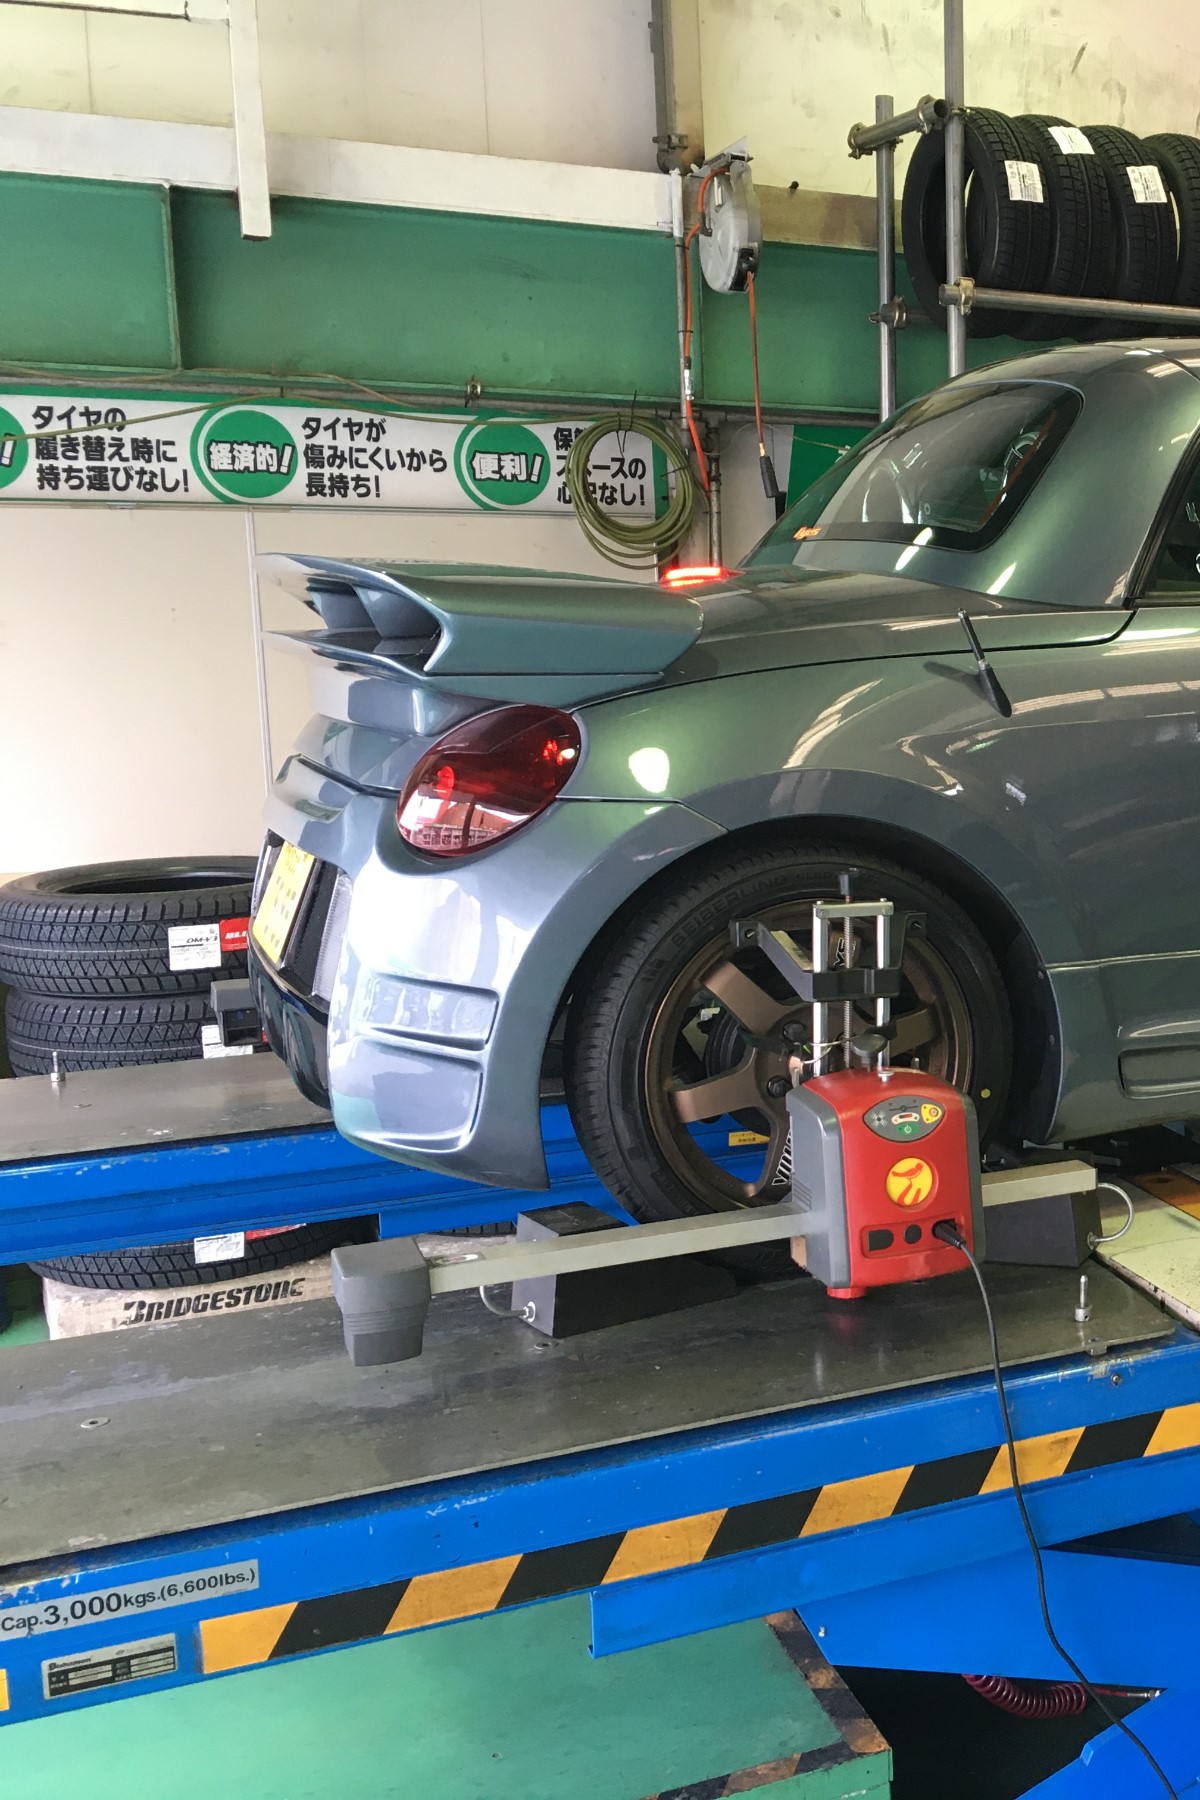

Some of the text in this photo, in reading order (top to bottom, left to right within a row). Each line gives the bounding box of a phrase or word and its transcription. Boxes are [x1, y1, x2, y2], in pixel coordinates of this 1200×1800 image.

[32, 405, 127, 432] タイヤの
[301, 417, 387, 442] タイヤが
[35, 434, 178, 464] 履き替え時に
[207, 440, 296, 475] 経済的!
[303, 443, 448, 472] 傷みにくいから
[36, 464, 190, 493] 持ち運びなし!
[470, 451, 545, 484] 便利!
[556, 454, 647, 480] スースの
[306, 472, 381, 498] 長持ち!
[186, 935, 219, 944] DM-V3
[118, 1277, 306, 1327] BRIDGESTONE
